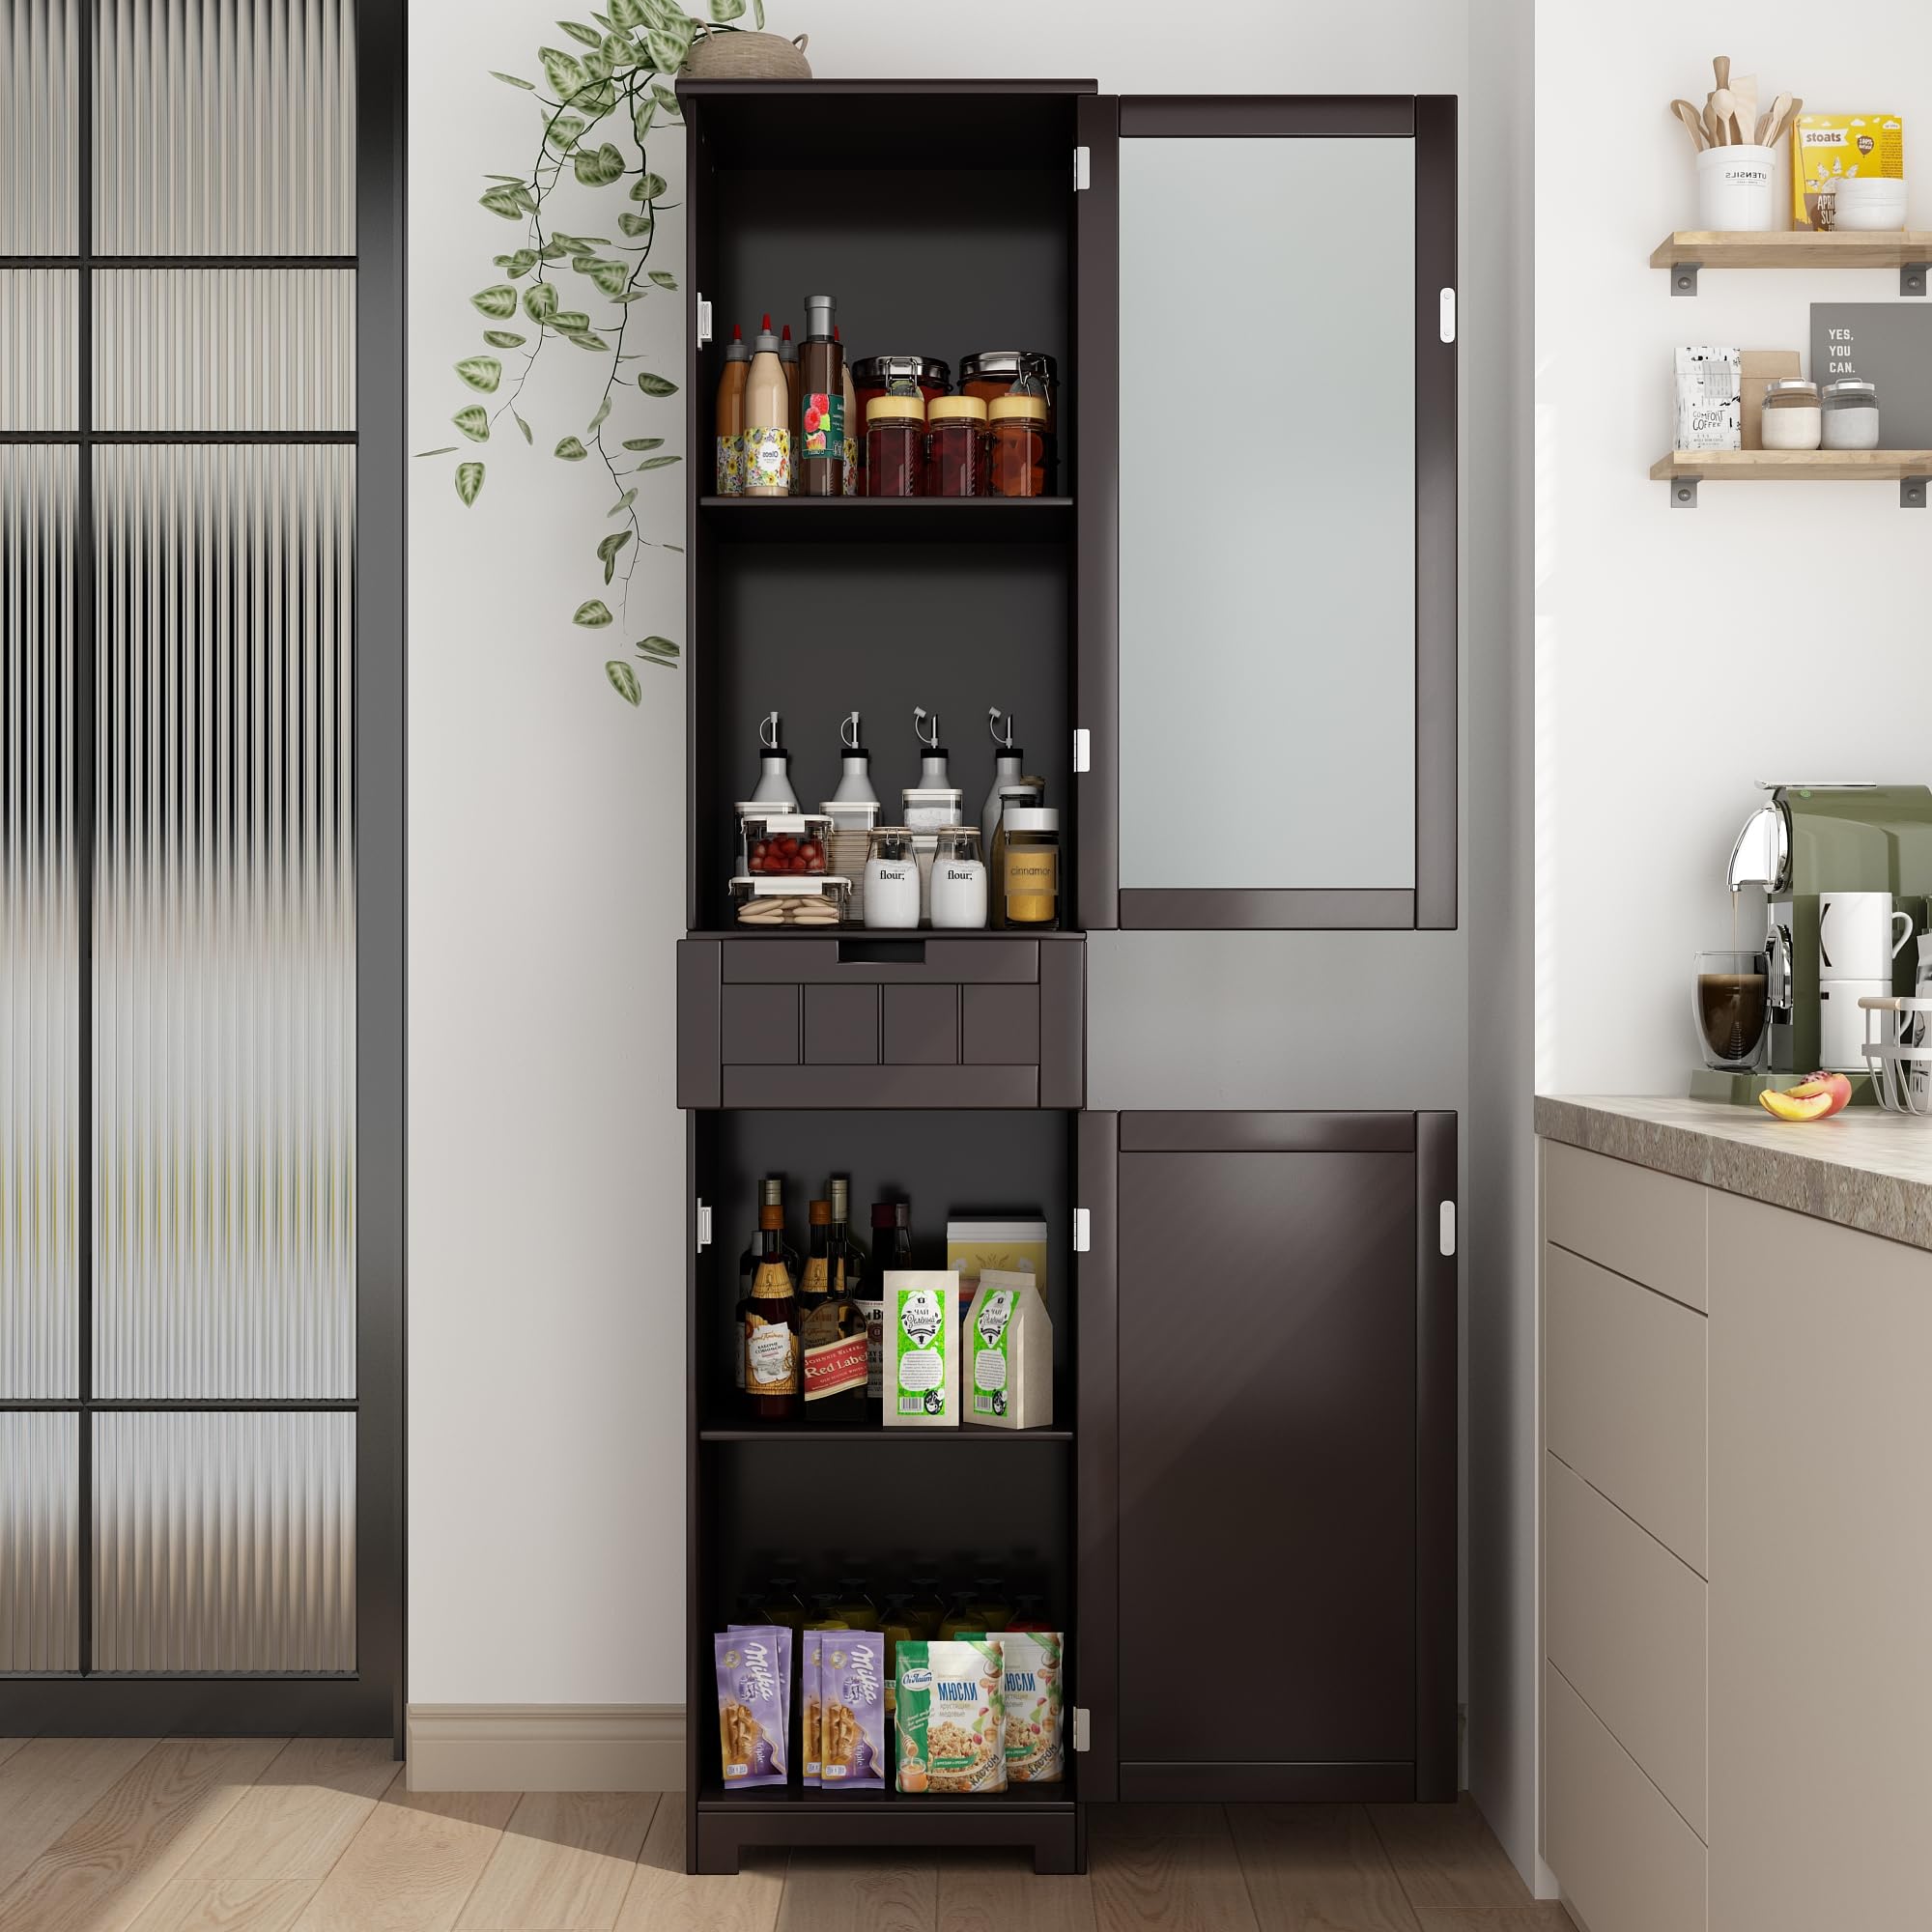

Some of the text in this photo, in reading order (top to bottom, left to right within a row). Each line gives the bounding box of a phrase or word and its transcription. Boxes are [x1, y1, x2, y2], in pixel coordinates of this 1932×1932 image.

[1805, 132, 1842, 143] stoats
[1817, 195, 1835, 211] APRI
[1821, 210, 1835, 224] SUL
[1828, 328, 1854, 341] YES,
[1829, 345, 1851, 356] YOU
[1829, 361, 1856, 373] CAN.
[1692, 410, 1725, 422] COMFORT
[1692, 417, 1720, 431] COFFEE
[805, 1362, 836, 1378] Red
[744, 1642, 774, 1702] Milka
[851, 1644, 879, 1705] Milka
[937, 1682, 978, 1701] МЮСЛИ
